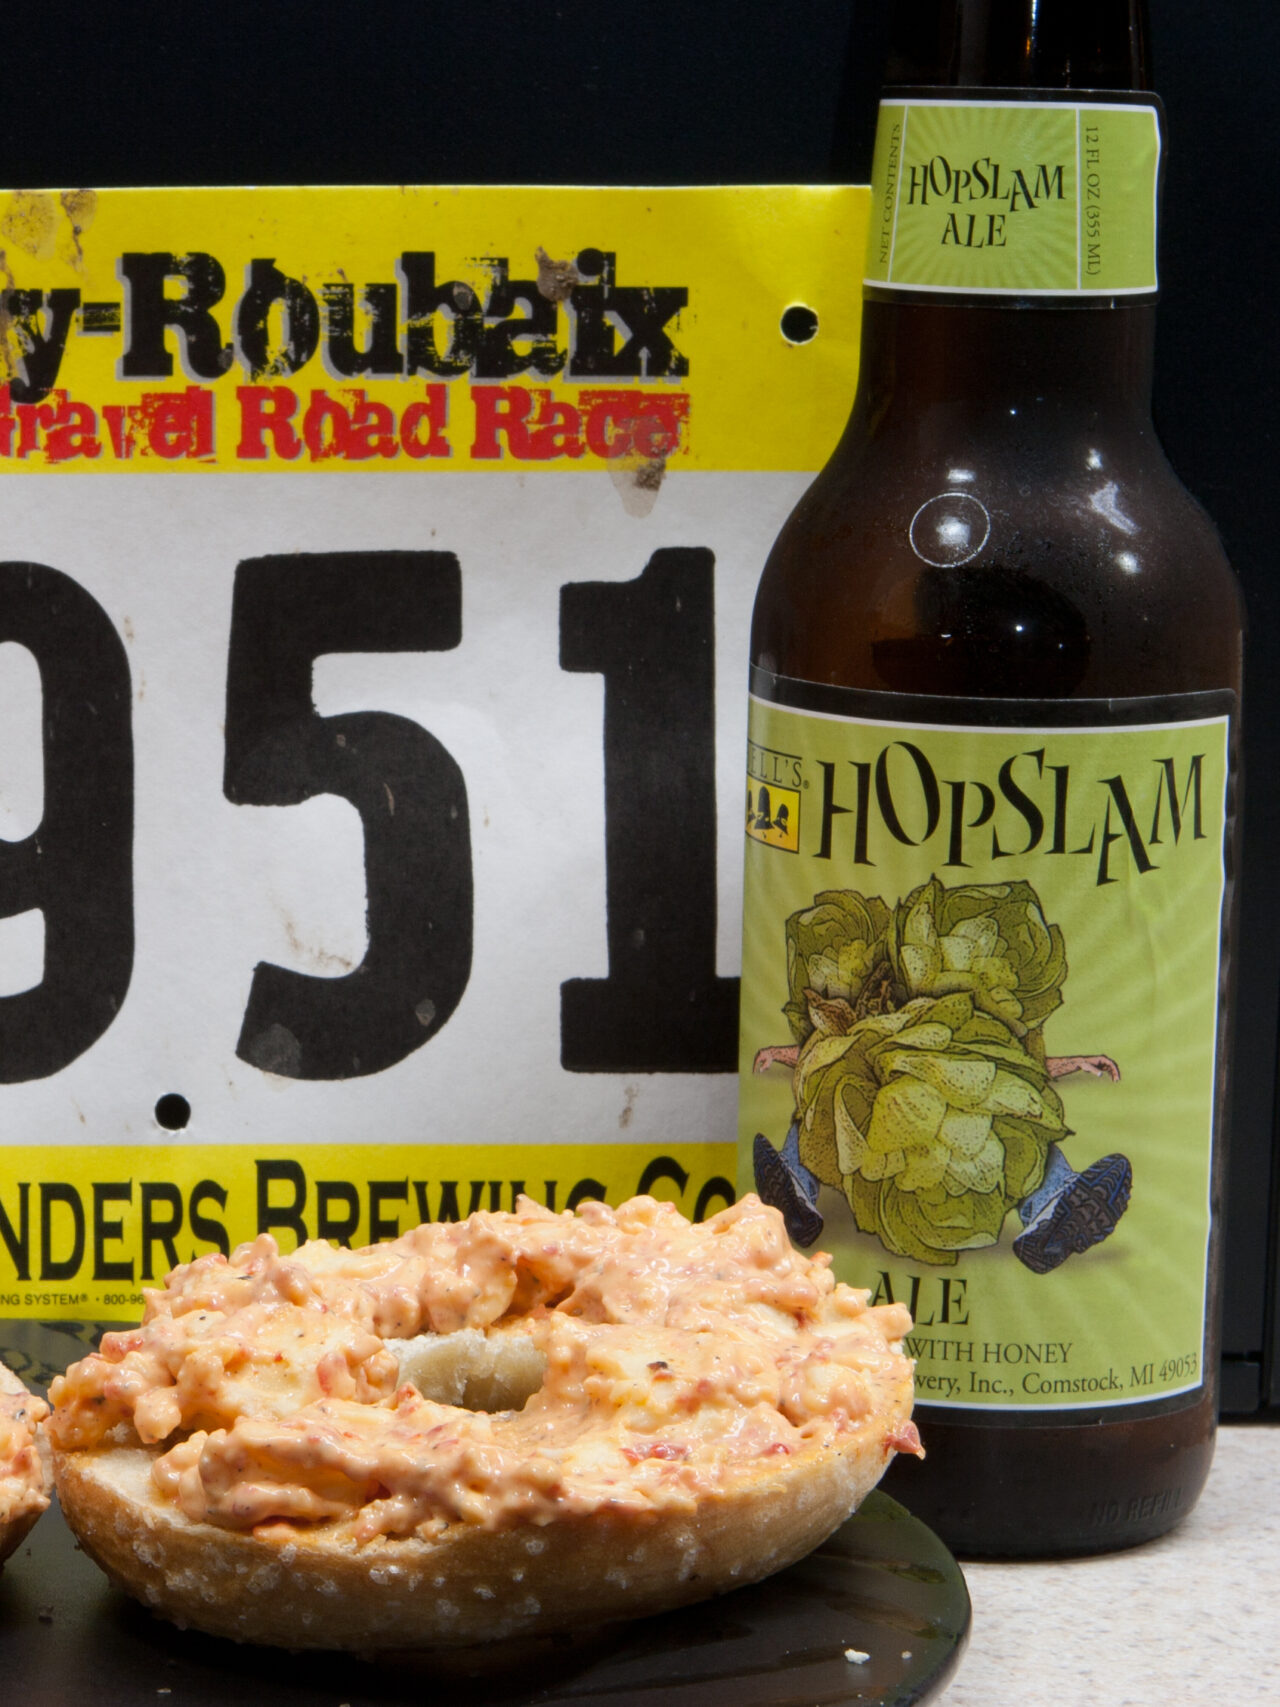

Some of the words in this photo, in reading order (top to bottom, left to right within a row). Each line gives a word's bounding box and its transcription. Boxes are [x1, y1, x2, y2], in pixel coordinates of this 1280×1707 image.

[1086, 126, 1099, 143] 12
[883, 124, 900, 222] CONTENTS
[1086, 149, 1099, 168] FL
[907, 155, 1066, 212] HOPSLAM
[1086, 173, 1100, 199] OZ
[941, 213, 1006, 248] ALE
[1085, 205, 1101, 237] (355
[880, 227, 889, 263] NET
[1086, 243, 1101, 275] ML)
[235, 383, 450, 462] Road
[470, 384, 690, 462] Race
[813, 741, 1207, 886] HOPSLAM
[103, 1293, 147, 1305] 800-96
[871, 1271, 969, 1326] ALE
[904, 1337, 974, 1362] WITH
[982, 1342, 1073, 1363] HONEY
[913, 1374, 961, 1398] wery,
[968, 1370, 1013, 1397] Inc.,
[1021, 1367, 1123, 1395] Comstock,
[1129, 1362, 1154, 1388] MI
[1159, 1352, 1198, 1381] 49053
